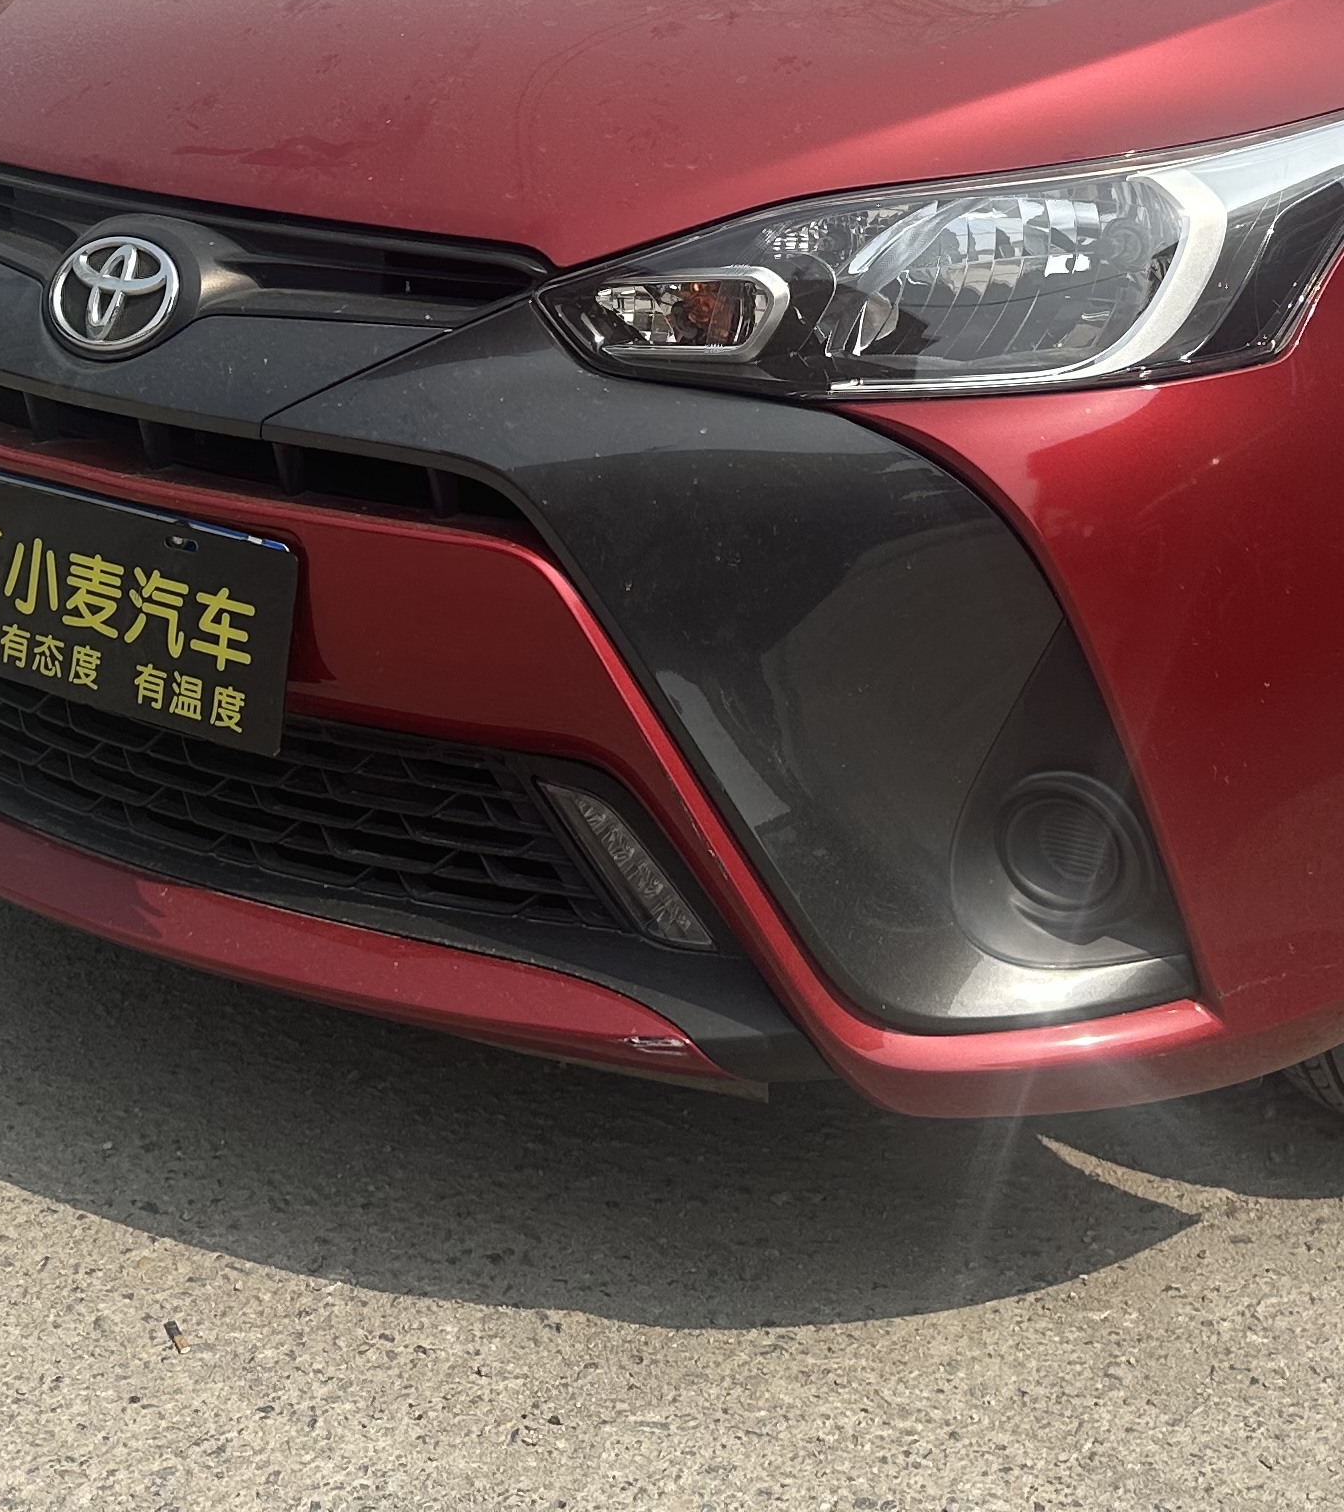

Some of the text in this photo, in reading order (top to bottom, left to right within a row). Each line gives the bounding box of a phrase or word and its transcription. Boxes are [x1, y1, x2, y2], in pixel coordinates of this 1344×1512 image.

[4, 537, 255, 672] 小麦汽车
[0, 623, 247, 734] 有态度 有温度
